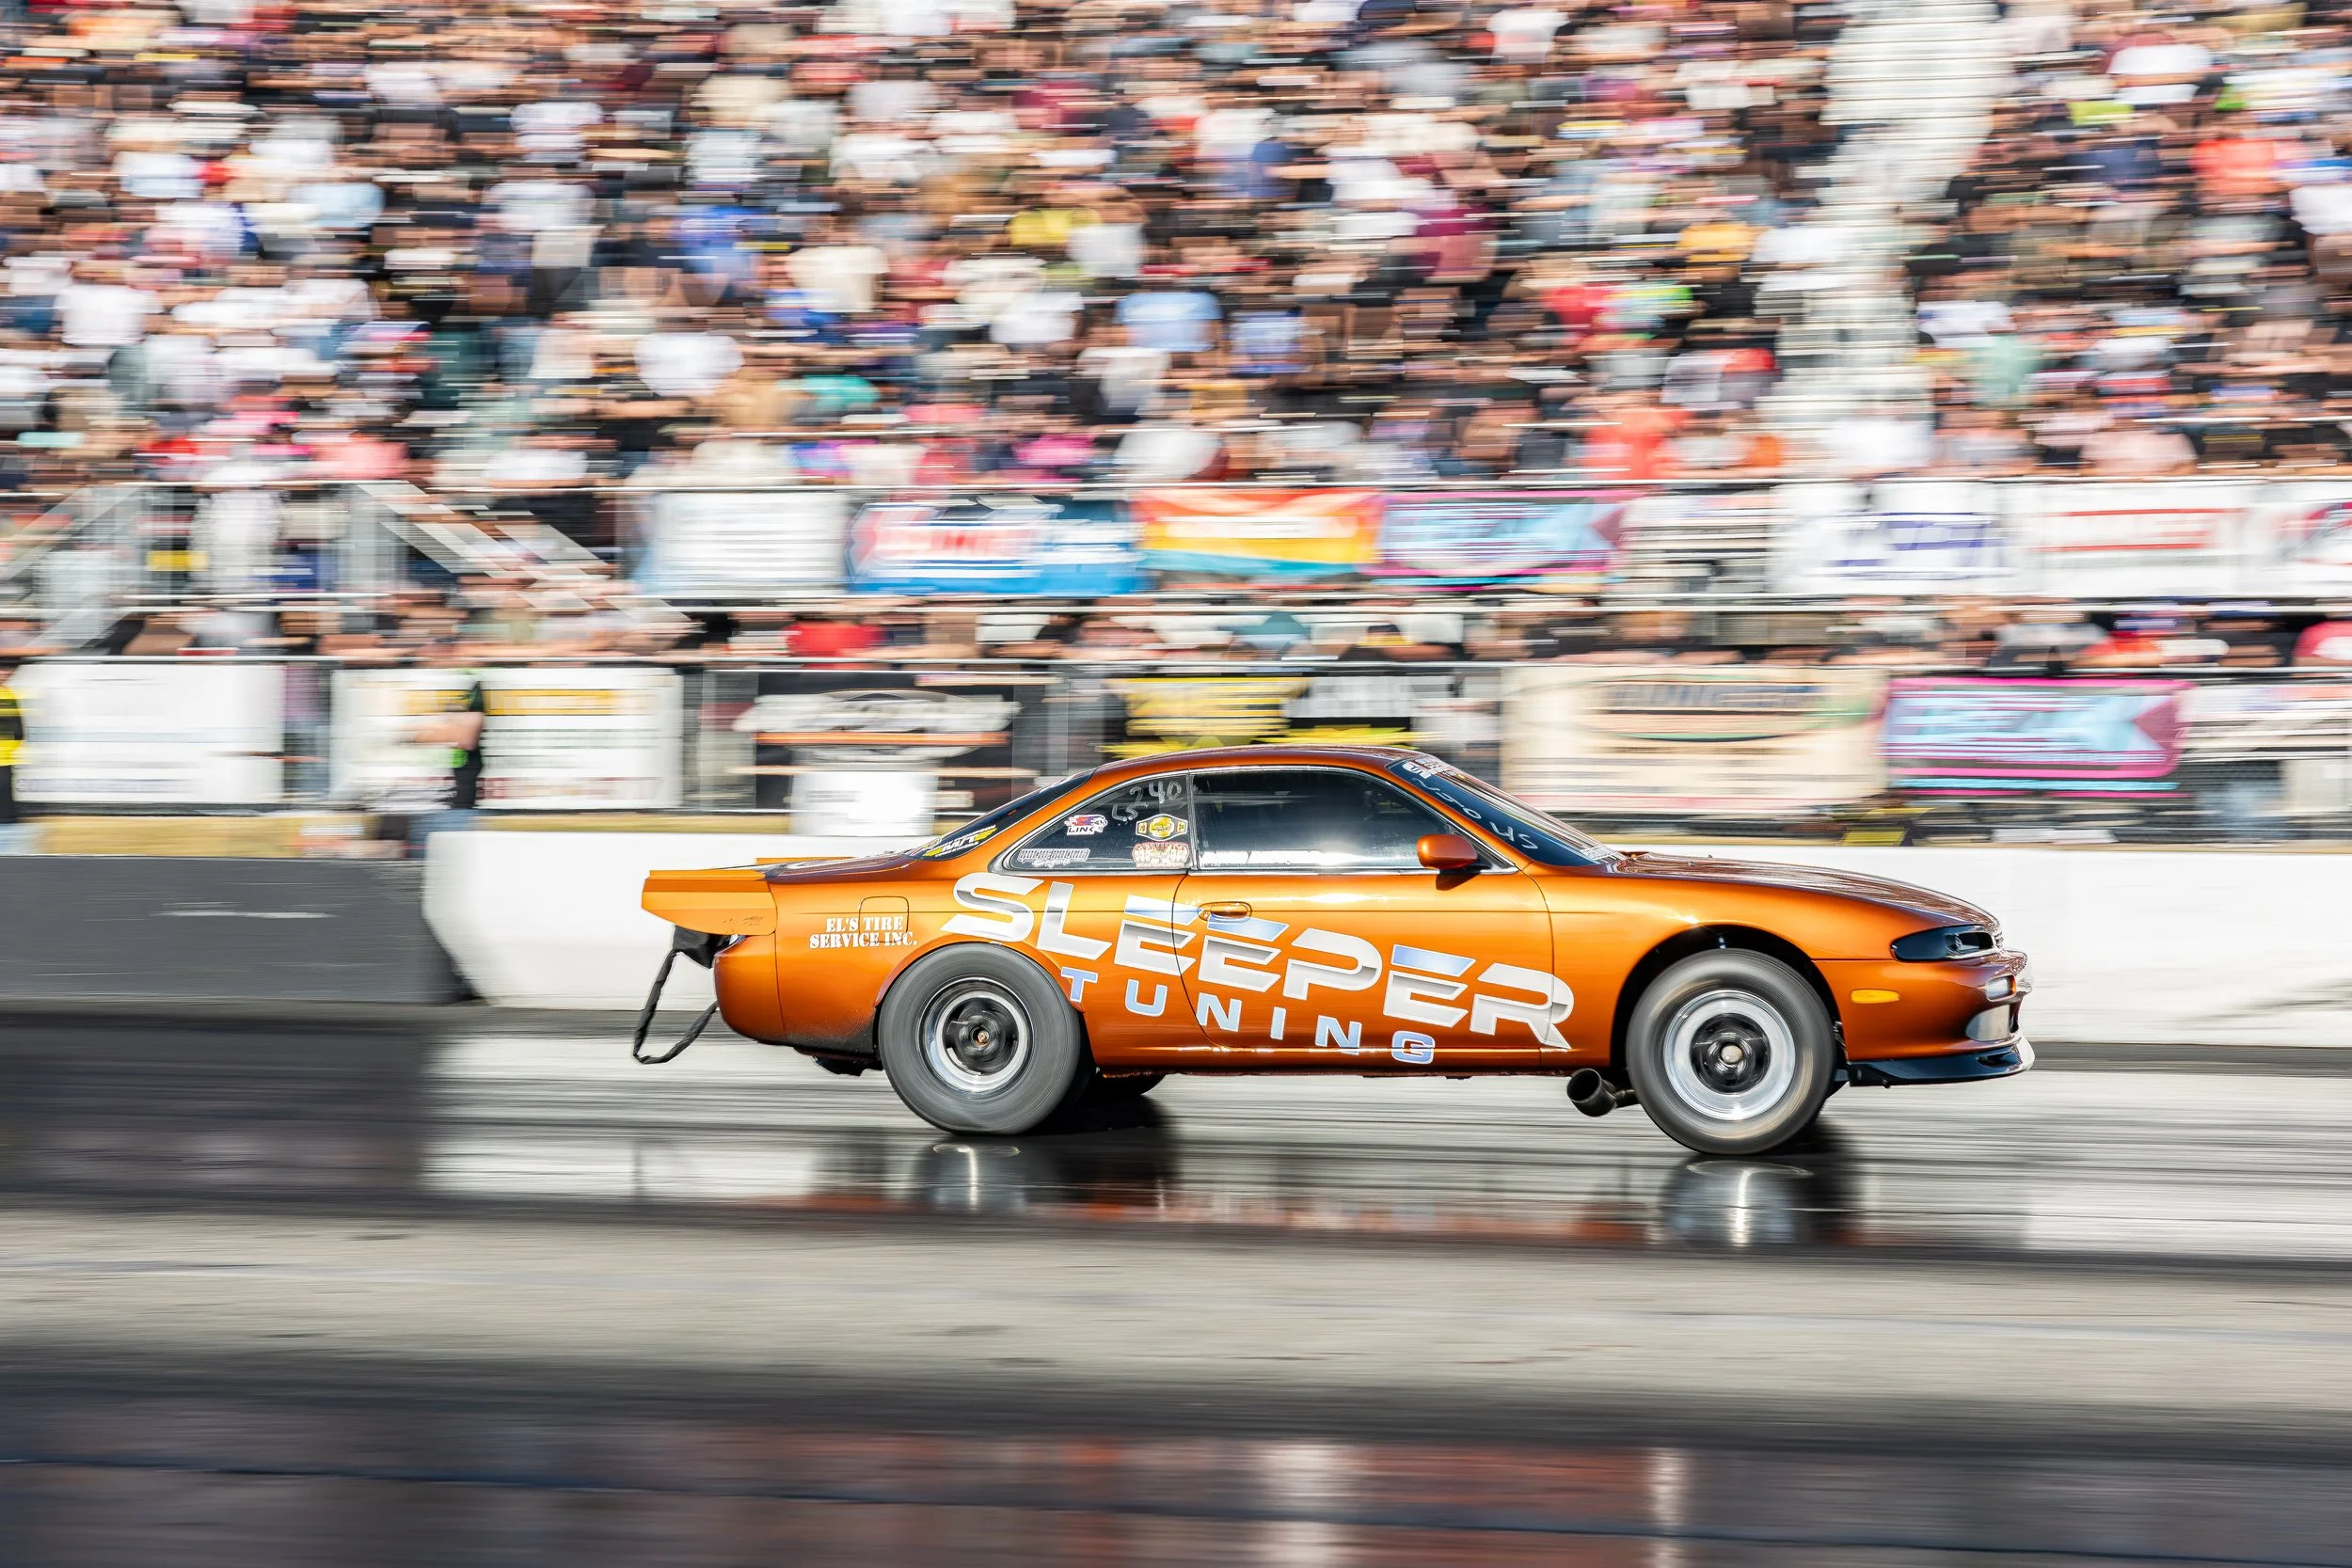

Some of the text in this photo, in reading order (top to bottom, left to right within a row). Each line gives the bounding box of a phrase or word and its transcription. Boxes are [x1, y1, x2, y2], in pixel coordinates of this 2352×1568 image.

[1129, 781, 1183, 808] 240
[826, 916, 904, 932] EL'S TIRE
[809, 931, 918, 948] SERVICE INC.
[940, 872, 1575, 1050] SLEEPER
[1060, 966, 1436, 1065] TUNING
